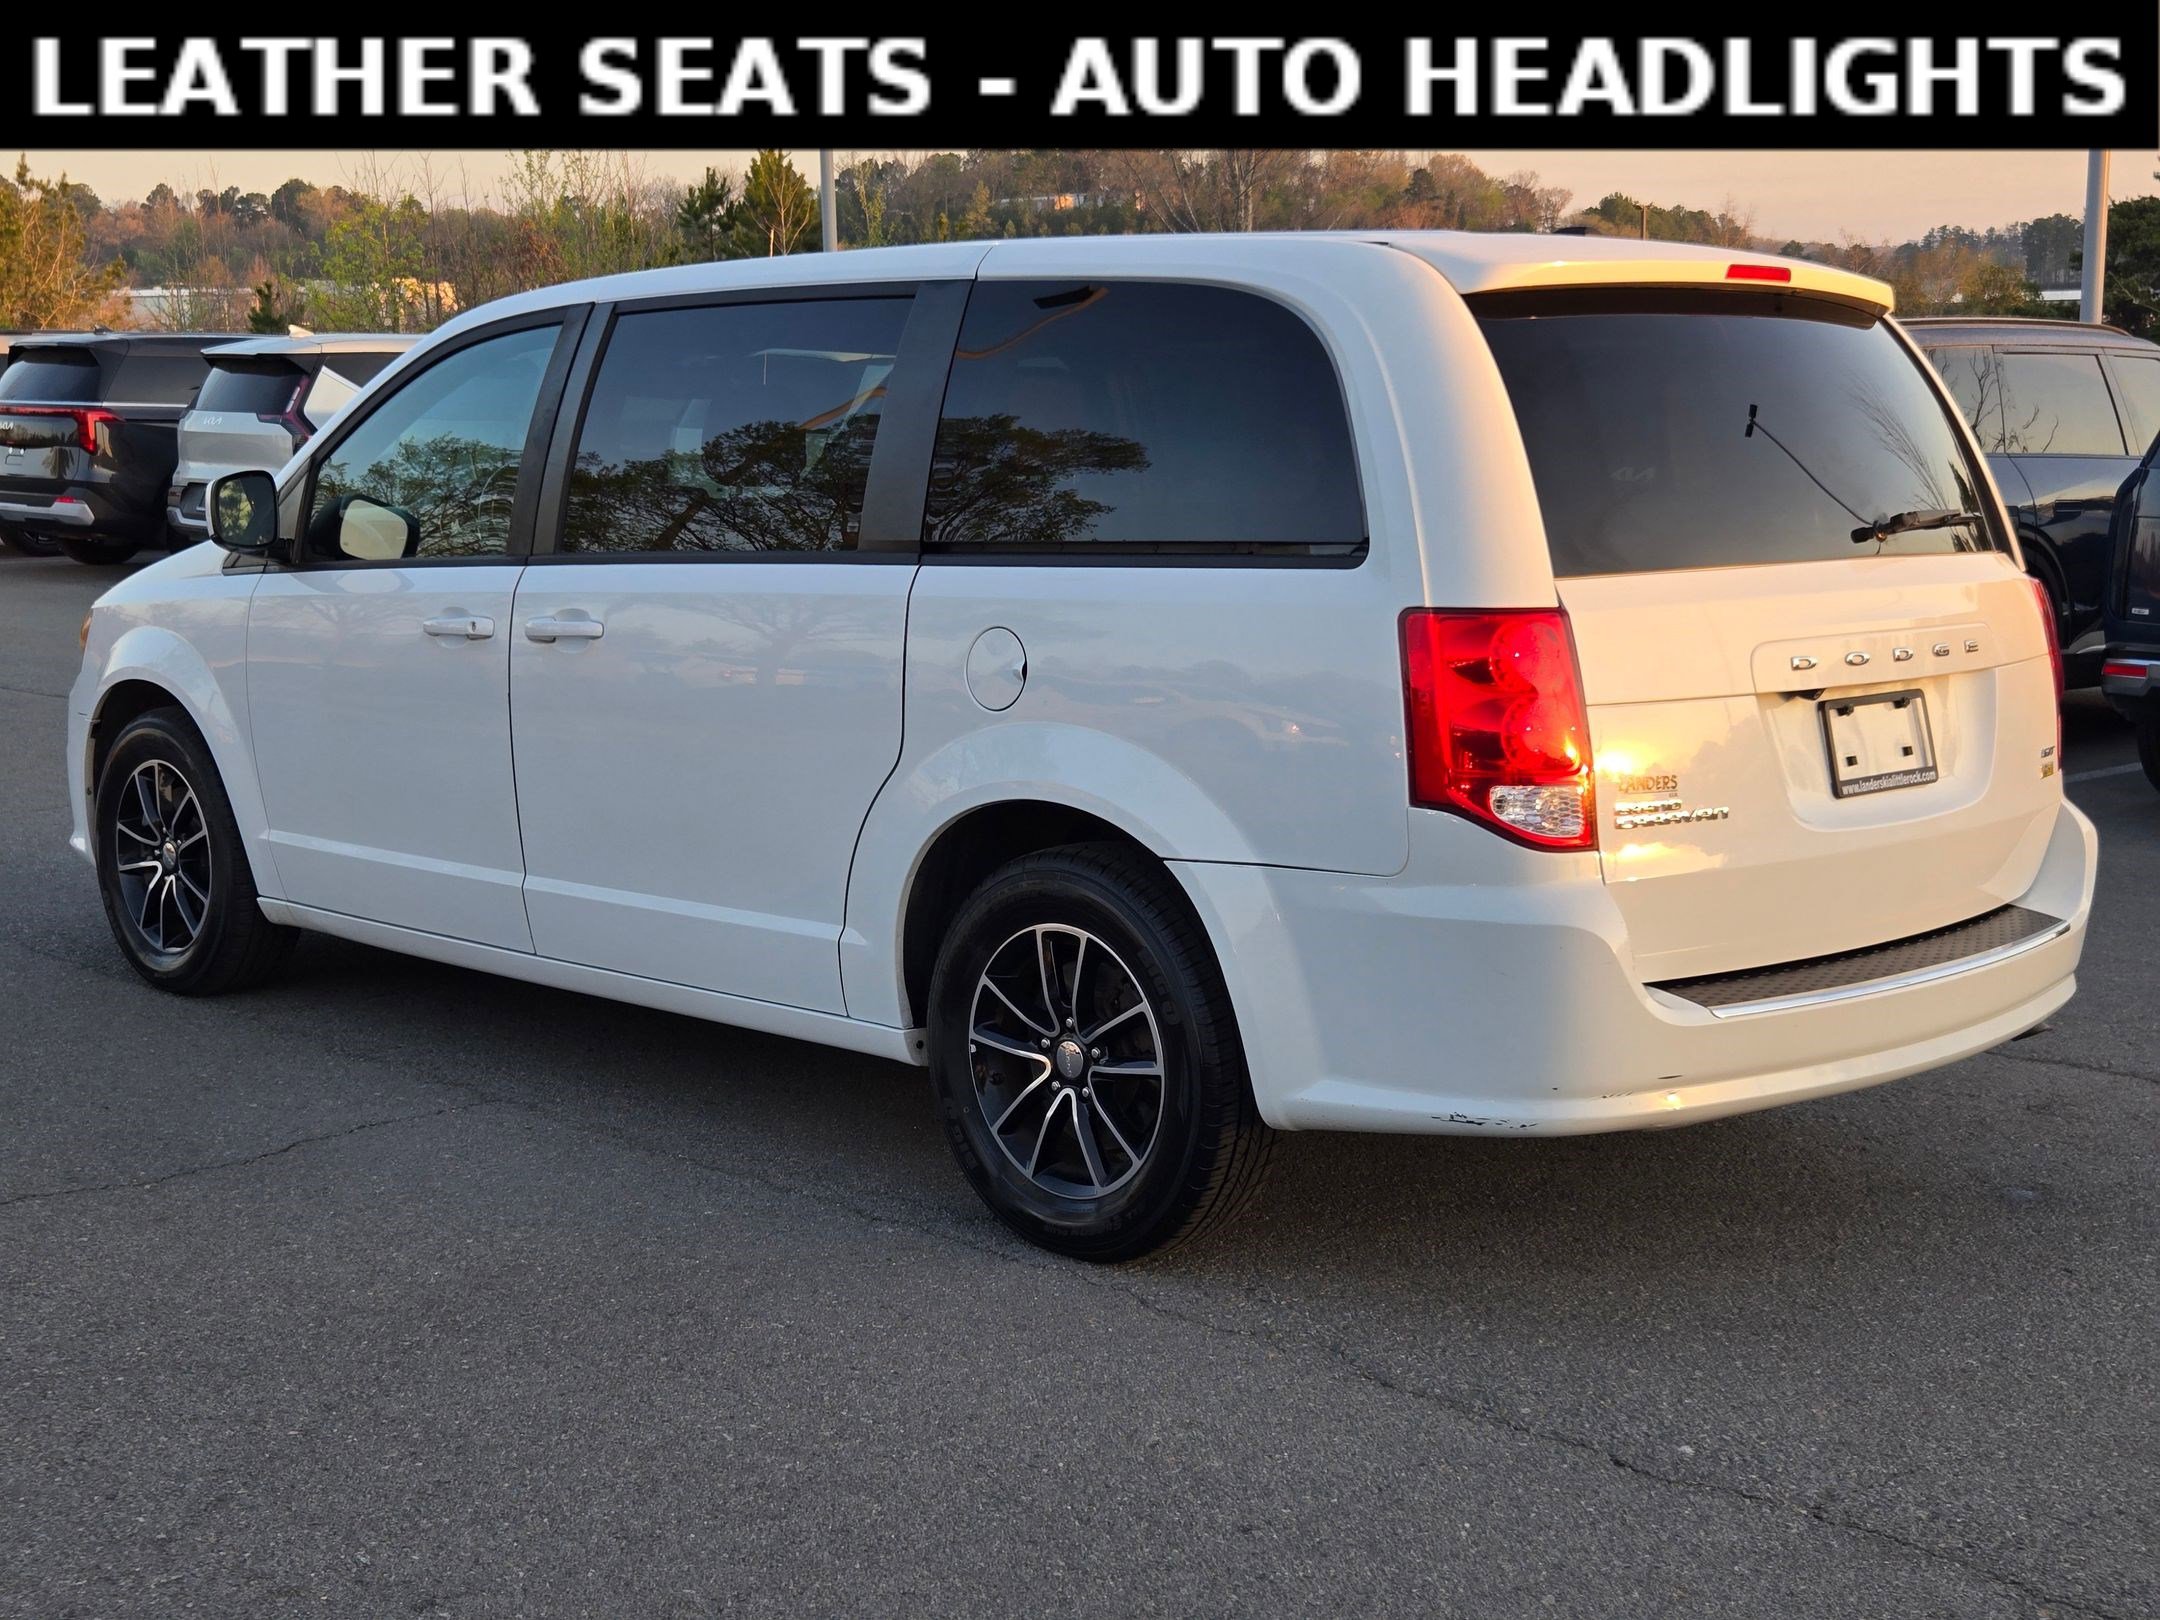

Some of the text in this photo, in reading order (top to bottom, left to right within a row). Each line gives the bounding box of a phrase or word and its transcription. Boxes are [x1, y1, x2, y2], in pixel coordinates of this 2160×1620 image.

[1790, 639, 1979, 671] DODGE
[1618, 774, 1679, 794] LANDERS
[1841, 771, 1936, 795] www.landerskialittlerock.com
